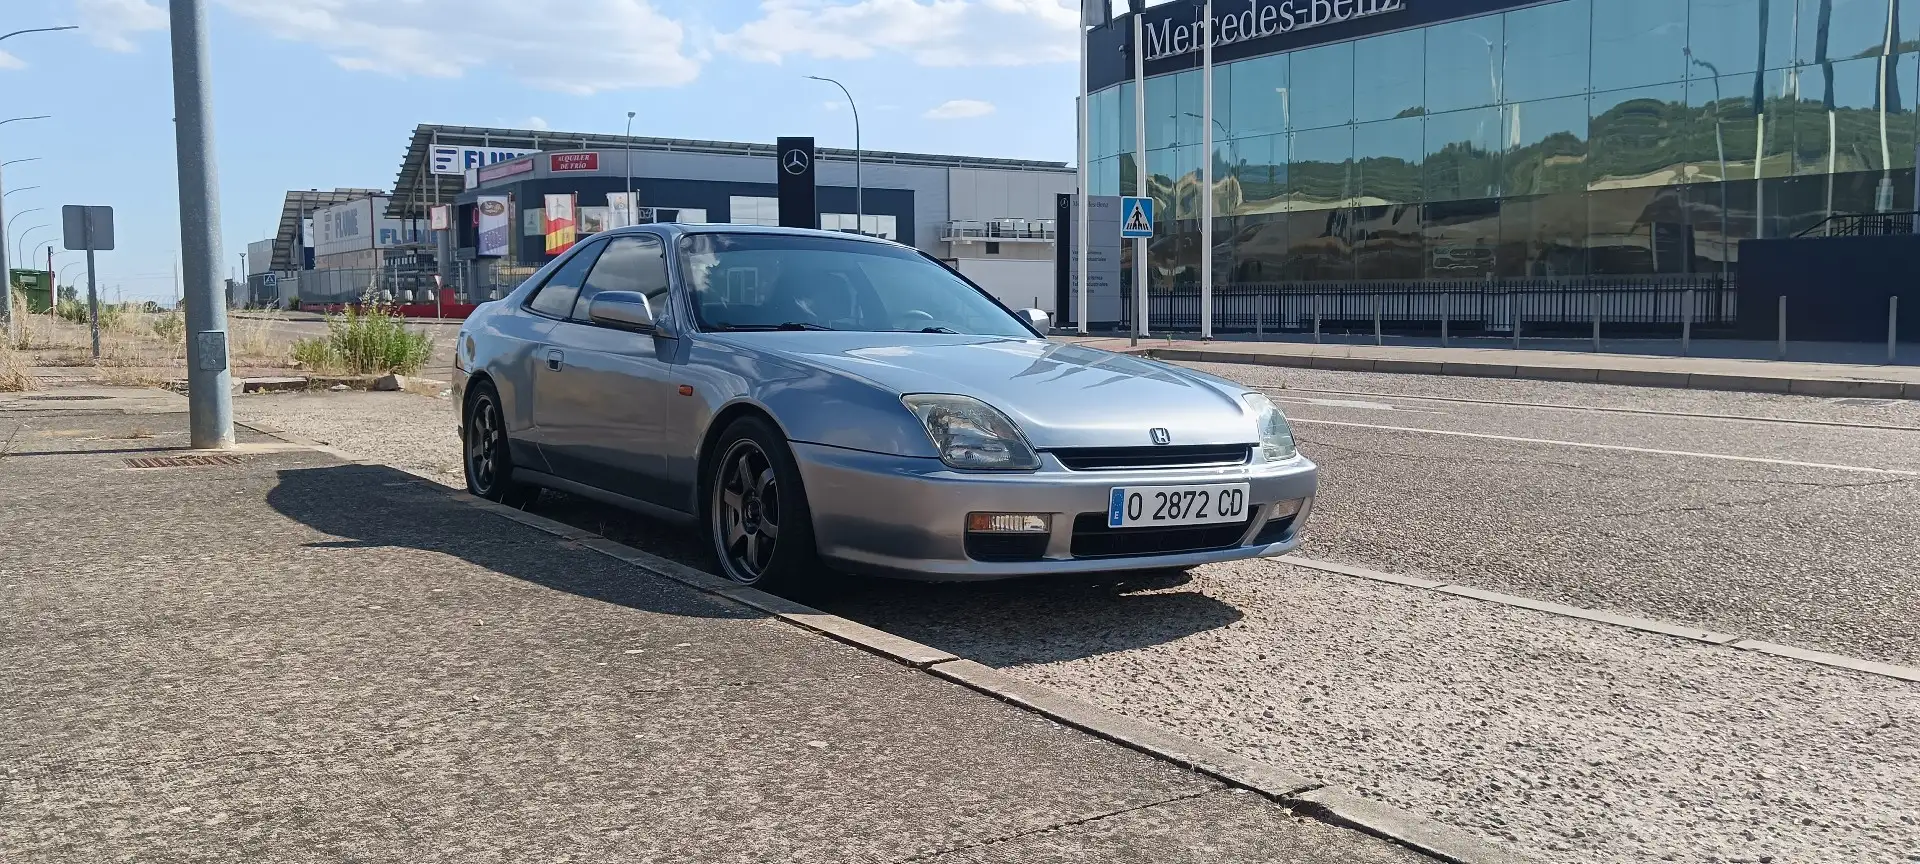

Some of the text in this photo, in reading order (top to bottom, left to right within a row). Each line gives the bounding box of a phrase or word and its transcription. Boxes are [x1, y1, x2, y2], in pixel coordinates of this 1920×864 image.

[557, 155, 590, 163] ALQUILER
[1114, 511, 1119, 519] E
[1152, 490, 1210, 520] 2872
[1217, 488, 1243, 517] CD
